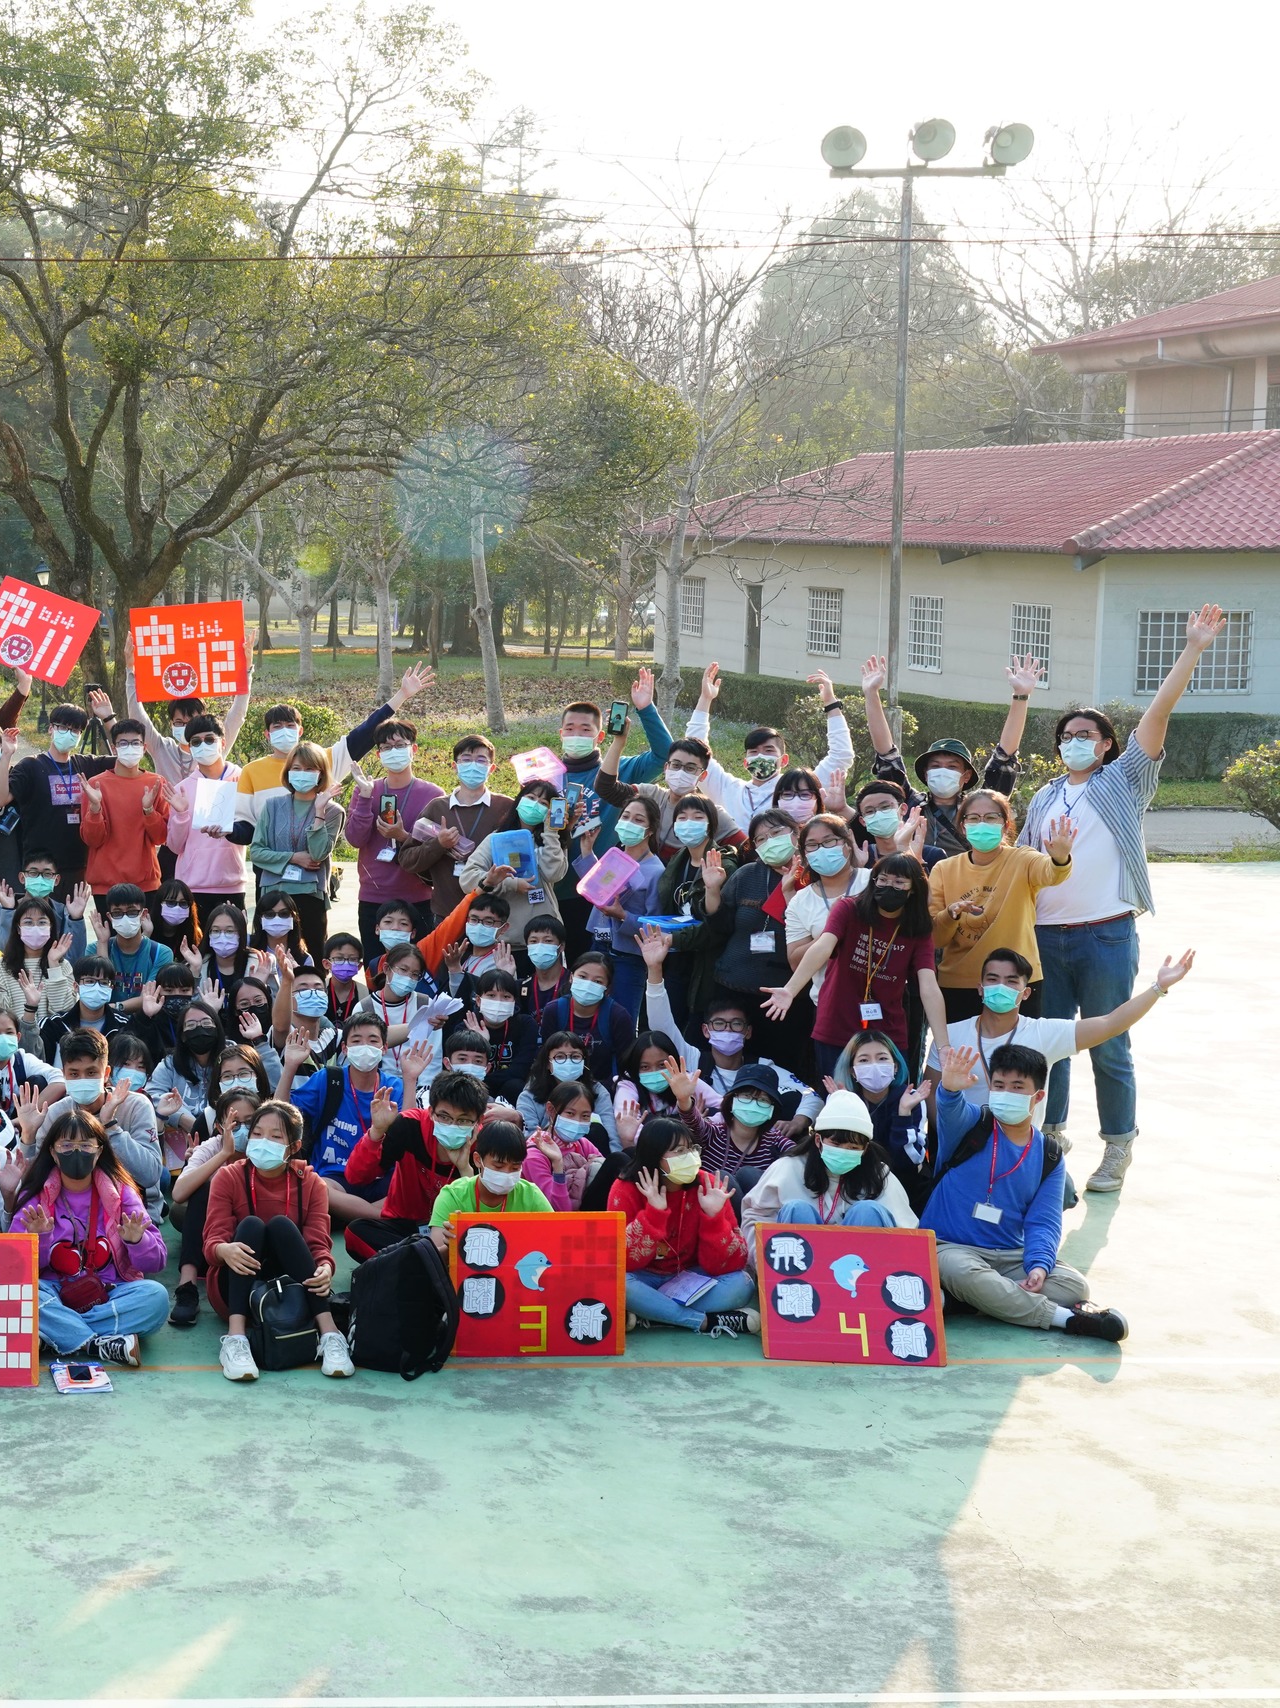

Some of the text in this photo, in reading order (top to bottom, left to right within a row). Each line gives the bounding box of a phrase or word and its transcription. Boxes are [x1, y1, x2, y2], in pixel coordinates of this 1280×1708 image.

[135, 615, 175, 676] 中
[198, 640, 237, 693] 12
[519, 1305, 548, 1353] 3
[569, 1301, 608, 1341] 新
[838, 1312, 869, 1357] 4
